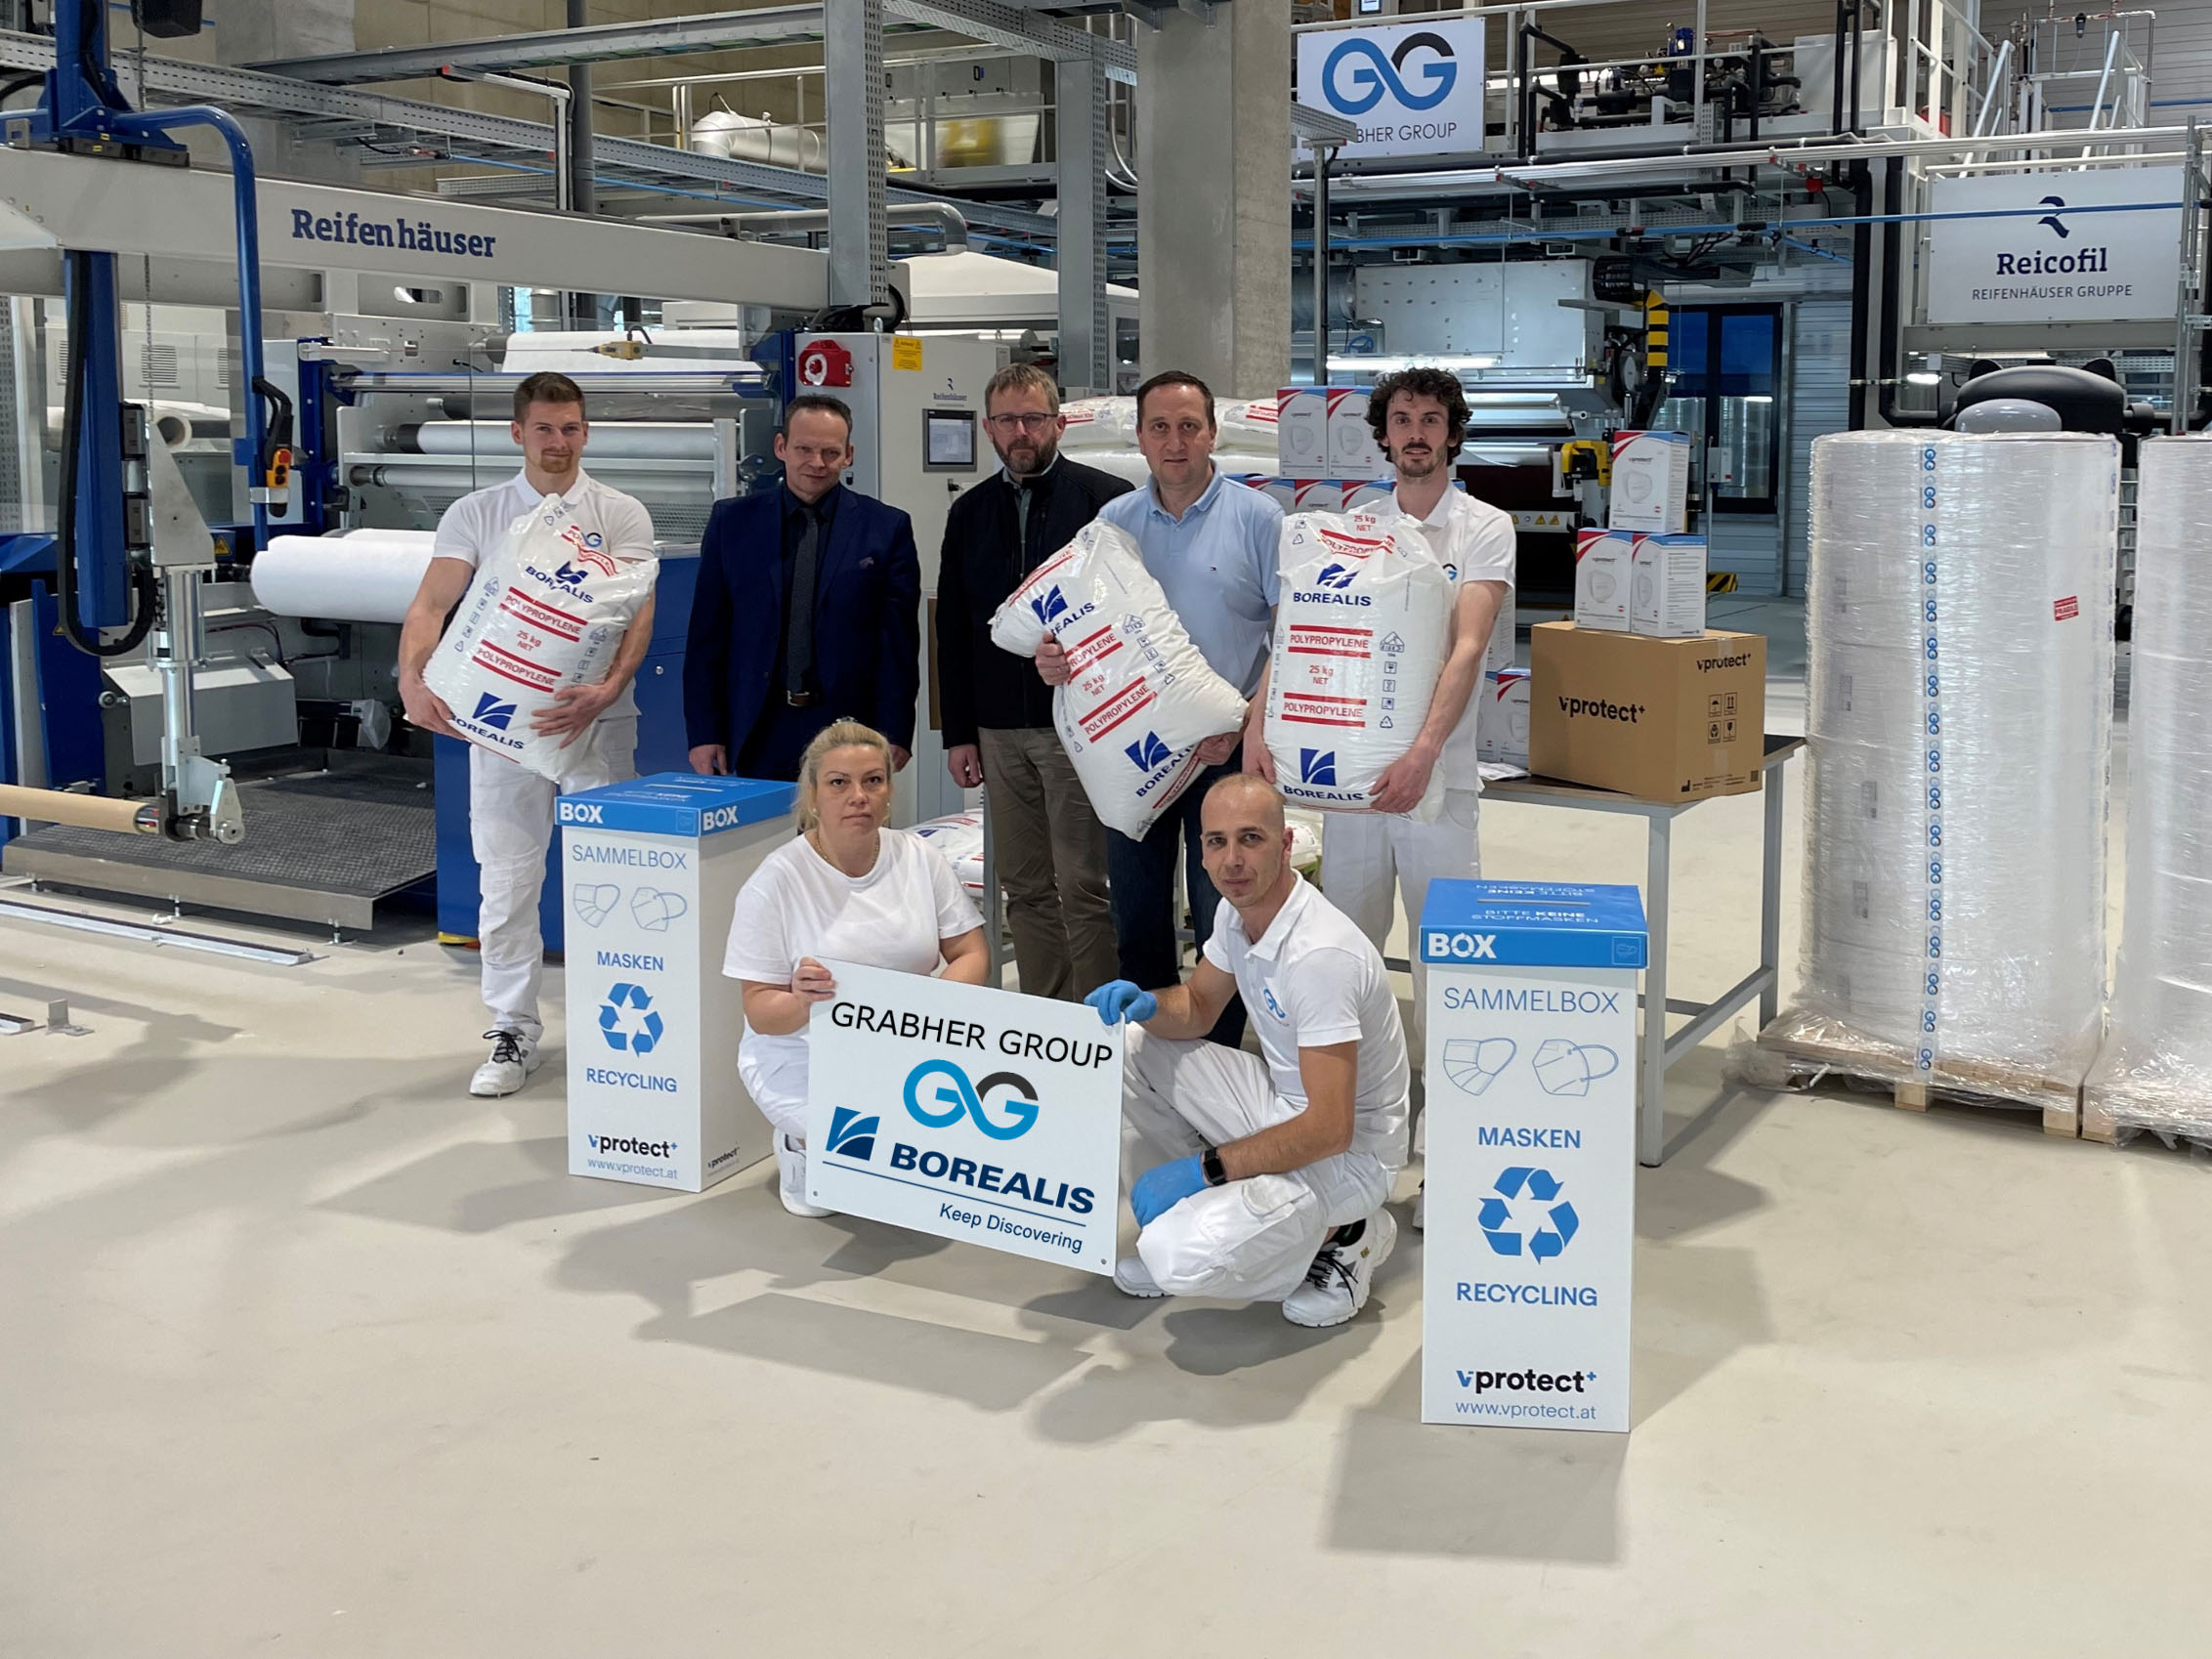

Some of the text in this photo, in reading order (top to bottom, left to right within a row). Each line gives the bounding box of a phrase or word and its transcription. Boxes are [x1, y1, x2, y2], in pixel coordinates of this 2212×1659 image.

[1399, 123, 1457, 141] GROUP
[291, 209, 496, 258] Reifenhäuser
[1996, 247, 2107, 276] Reicofil
[1973, 284, 2133, 300] REIFENHÄUSER GRUPPE
[1365, 515, 1376, 525] kg
[1293, 592, 1372, 607] BOREALIS
[505, 594, 582, 635] POLYPROPYLENE
[516, 630, 542, 648] 25 kg
[517, 640, 533, 652] NET
[1290, 634, 1369, 649] POLYPROPYLENE
[477, 648, 555, 685] POLYPROPYLENE
[1308, 665, 1334, 677] 25 kg
[1082, 674, 1106, 692] 25 kg
[1091, 685, 1105, 697] NET
[1085, 684, 1151, 735] POLYPROPYLENE
[1284, 702, 1364, 718] POLYPROPYLENE
[1283, 785, 1365, 801] BOREALIS
[560, 802, 604, 824] BOX
[702, 805, 739, 830] BOX
[573, 844, 688, 870] SAMMELBOX
[1471, 915, 1598, 923] STOFFMASKEN
[1427, 932, 1497, 958] BOX
[597, 951, 664, 971] MASKEN
[1444, 987, 1620, 1014] SAMMELBOX
[831, 1001, 1113, 1069] GRABHER GROUP
[586, 1068, 677, 1093] RECYCLING
[1478, 1127, 1581, 1148] MASKEN
[587, 1158, 678, 1179] www.vprotect.at
[889, 1142, 1095, 1214] BOREALIS
[940, 1203, 1084, 1255] Keep Discovering
[1457, 1282, 1597, 1306] RECYCLING
[1456, 1402, 1597, 1420] www.vprotect.at
